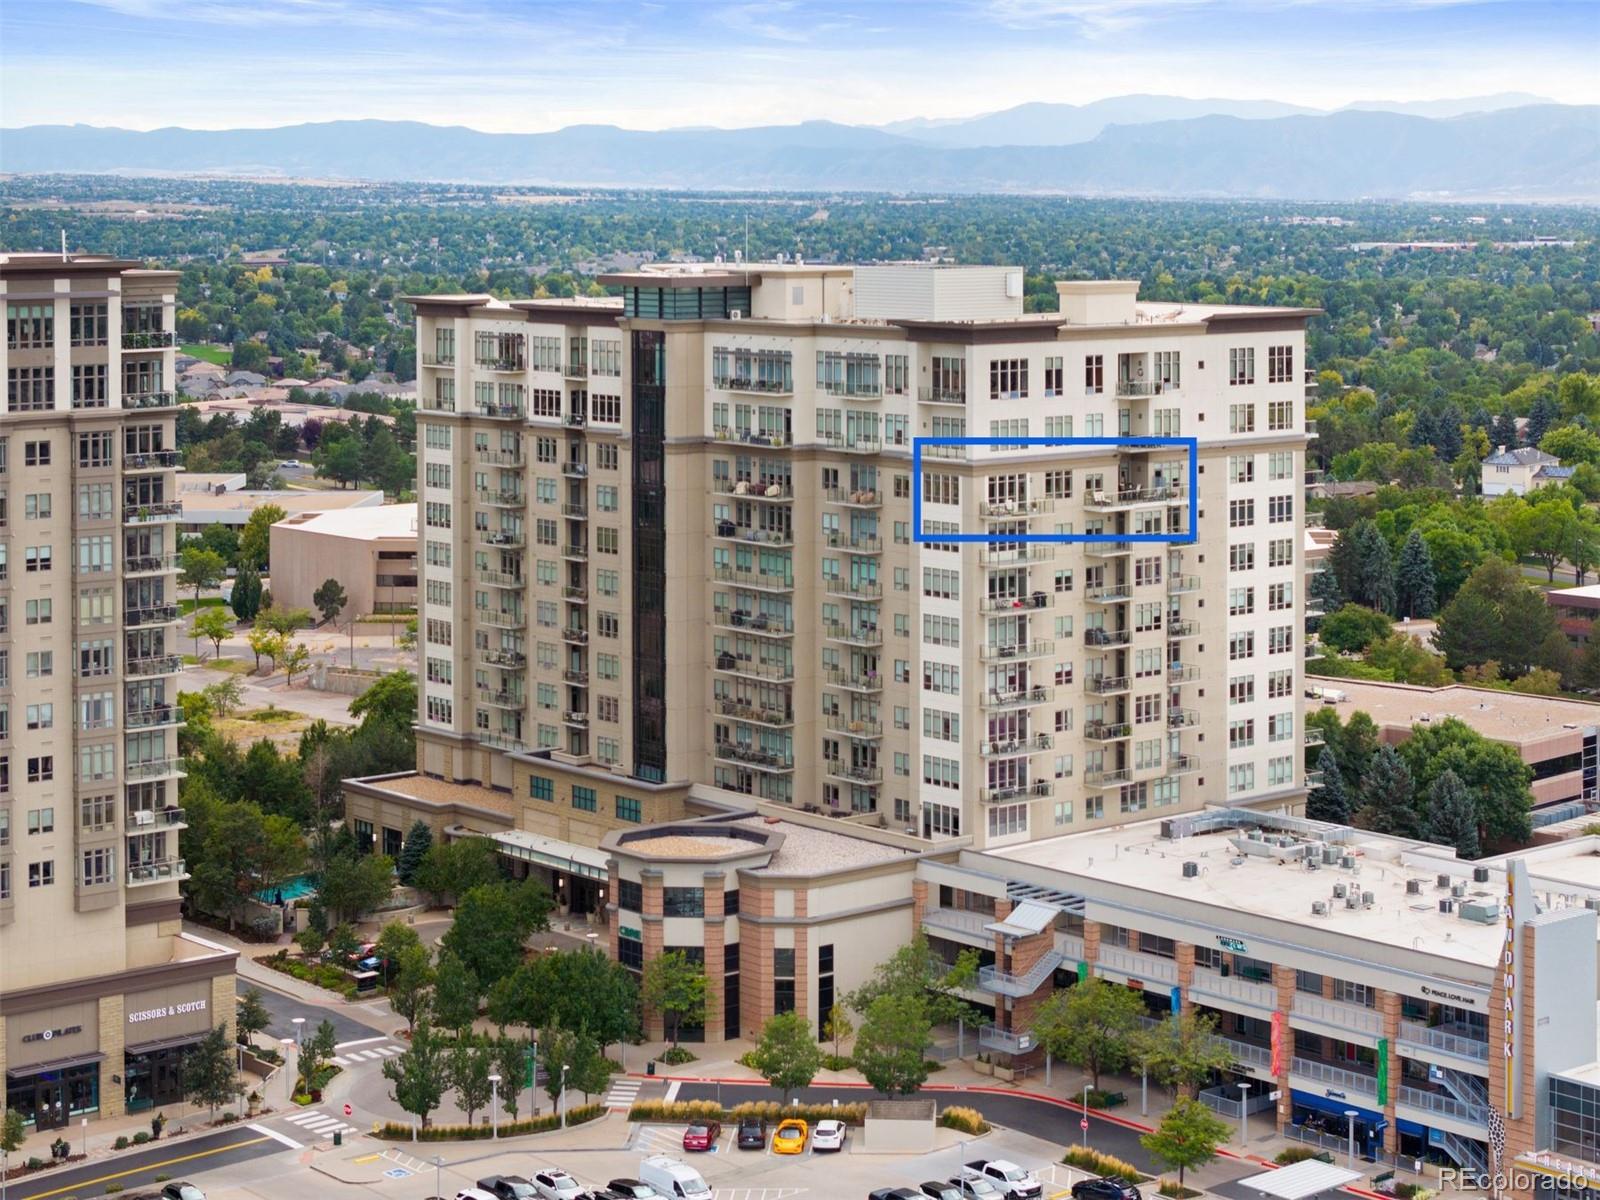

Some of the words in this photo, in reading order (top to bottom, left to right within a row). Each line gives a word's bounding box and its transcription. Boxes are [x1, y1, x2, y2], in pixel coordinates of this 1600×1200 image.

[128, 1007, 167, 1023] SCISSORS
[168, 1006, 175, 1016] &
[176, 1000, 207, 1014] SCOTCH
[1503, 881, 1514, 1057] LANDMARK
